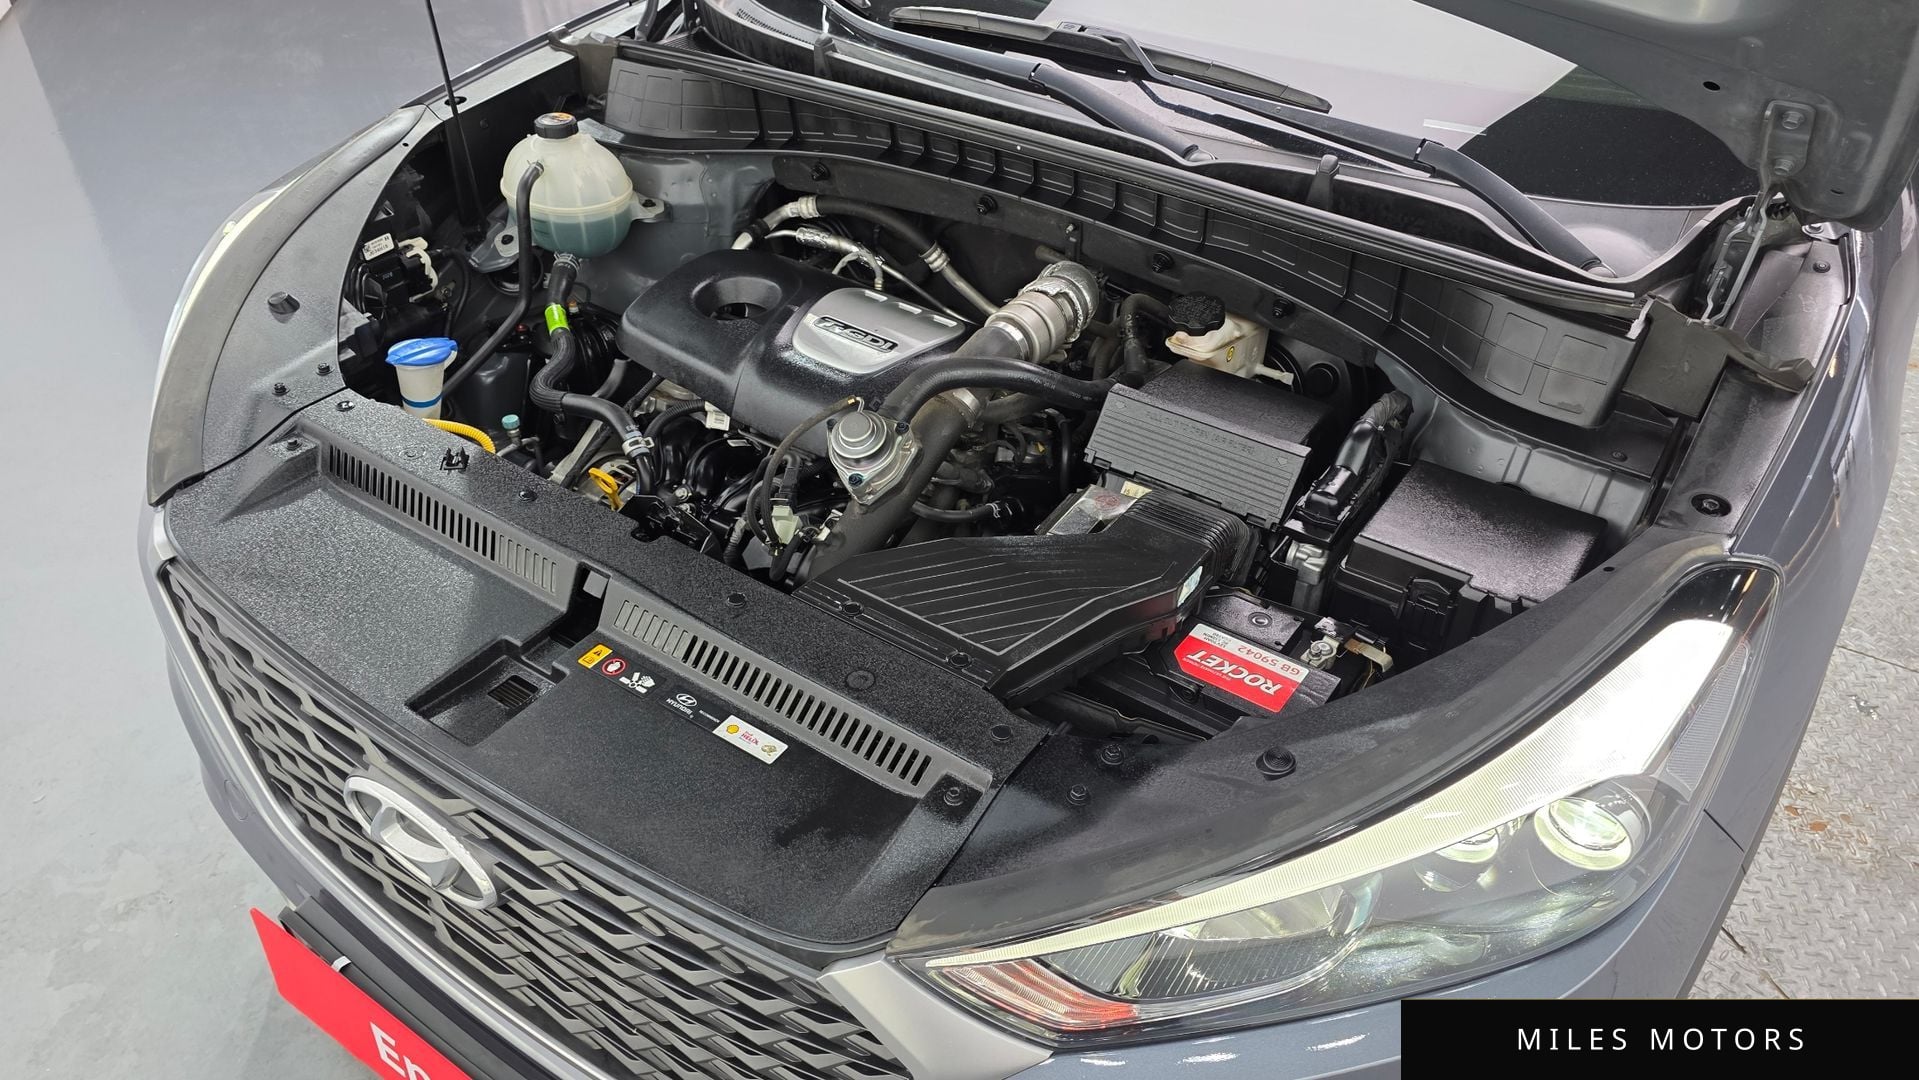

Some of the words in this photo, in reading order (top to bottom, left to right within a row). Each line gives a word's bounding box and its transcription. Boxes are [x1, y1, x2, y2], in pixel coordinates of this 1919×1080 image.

[1238, 645, 1280, 667] 59042
[1185, 650, 1283, 695] ROCKET
[1280, 663, 1301, 676] GB
[666, 698, 693, 715] HYUNDAI
